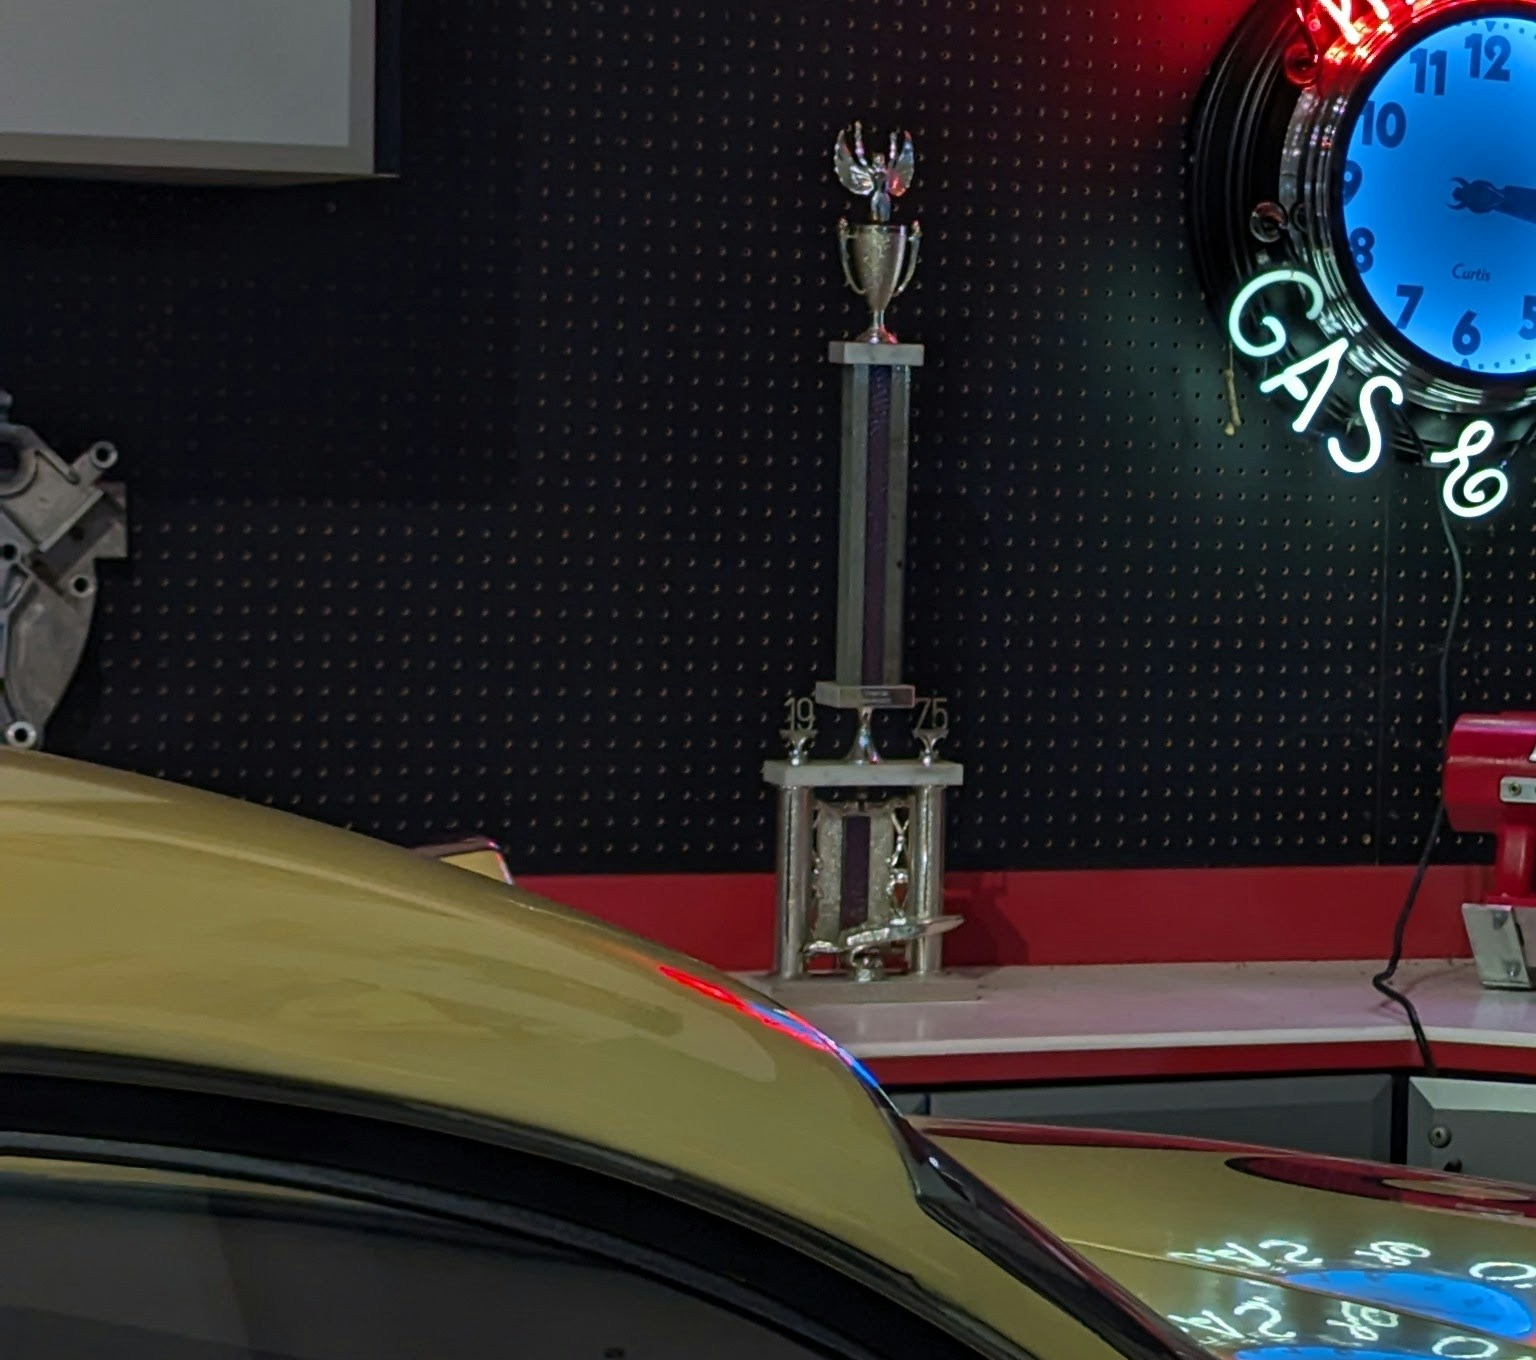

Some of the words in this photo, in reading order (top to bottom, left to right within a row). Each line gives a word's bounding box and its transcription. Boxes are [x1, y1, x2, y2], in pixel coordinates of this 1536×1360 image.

[1409, 47, 1447, 96] 11
[1464, 34, 1512, 82] 12
[1360, 101, 1406, 148] 10
[1350, 227, 1375, 273] 8
[1451, 262, 1492, 282] Curtis
[1396, 284, 1424, 329] 7
[1452, 310, 1481, 356] 6
[1228, 268, 1405, 474] GAS
[1428, 421, 1510, 518] &
[784, 697, 815, 730] 19
[915, 697, 948, 730] 75
